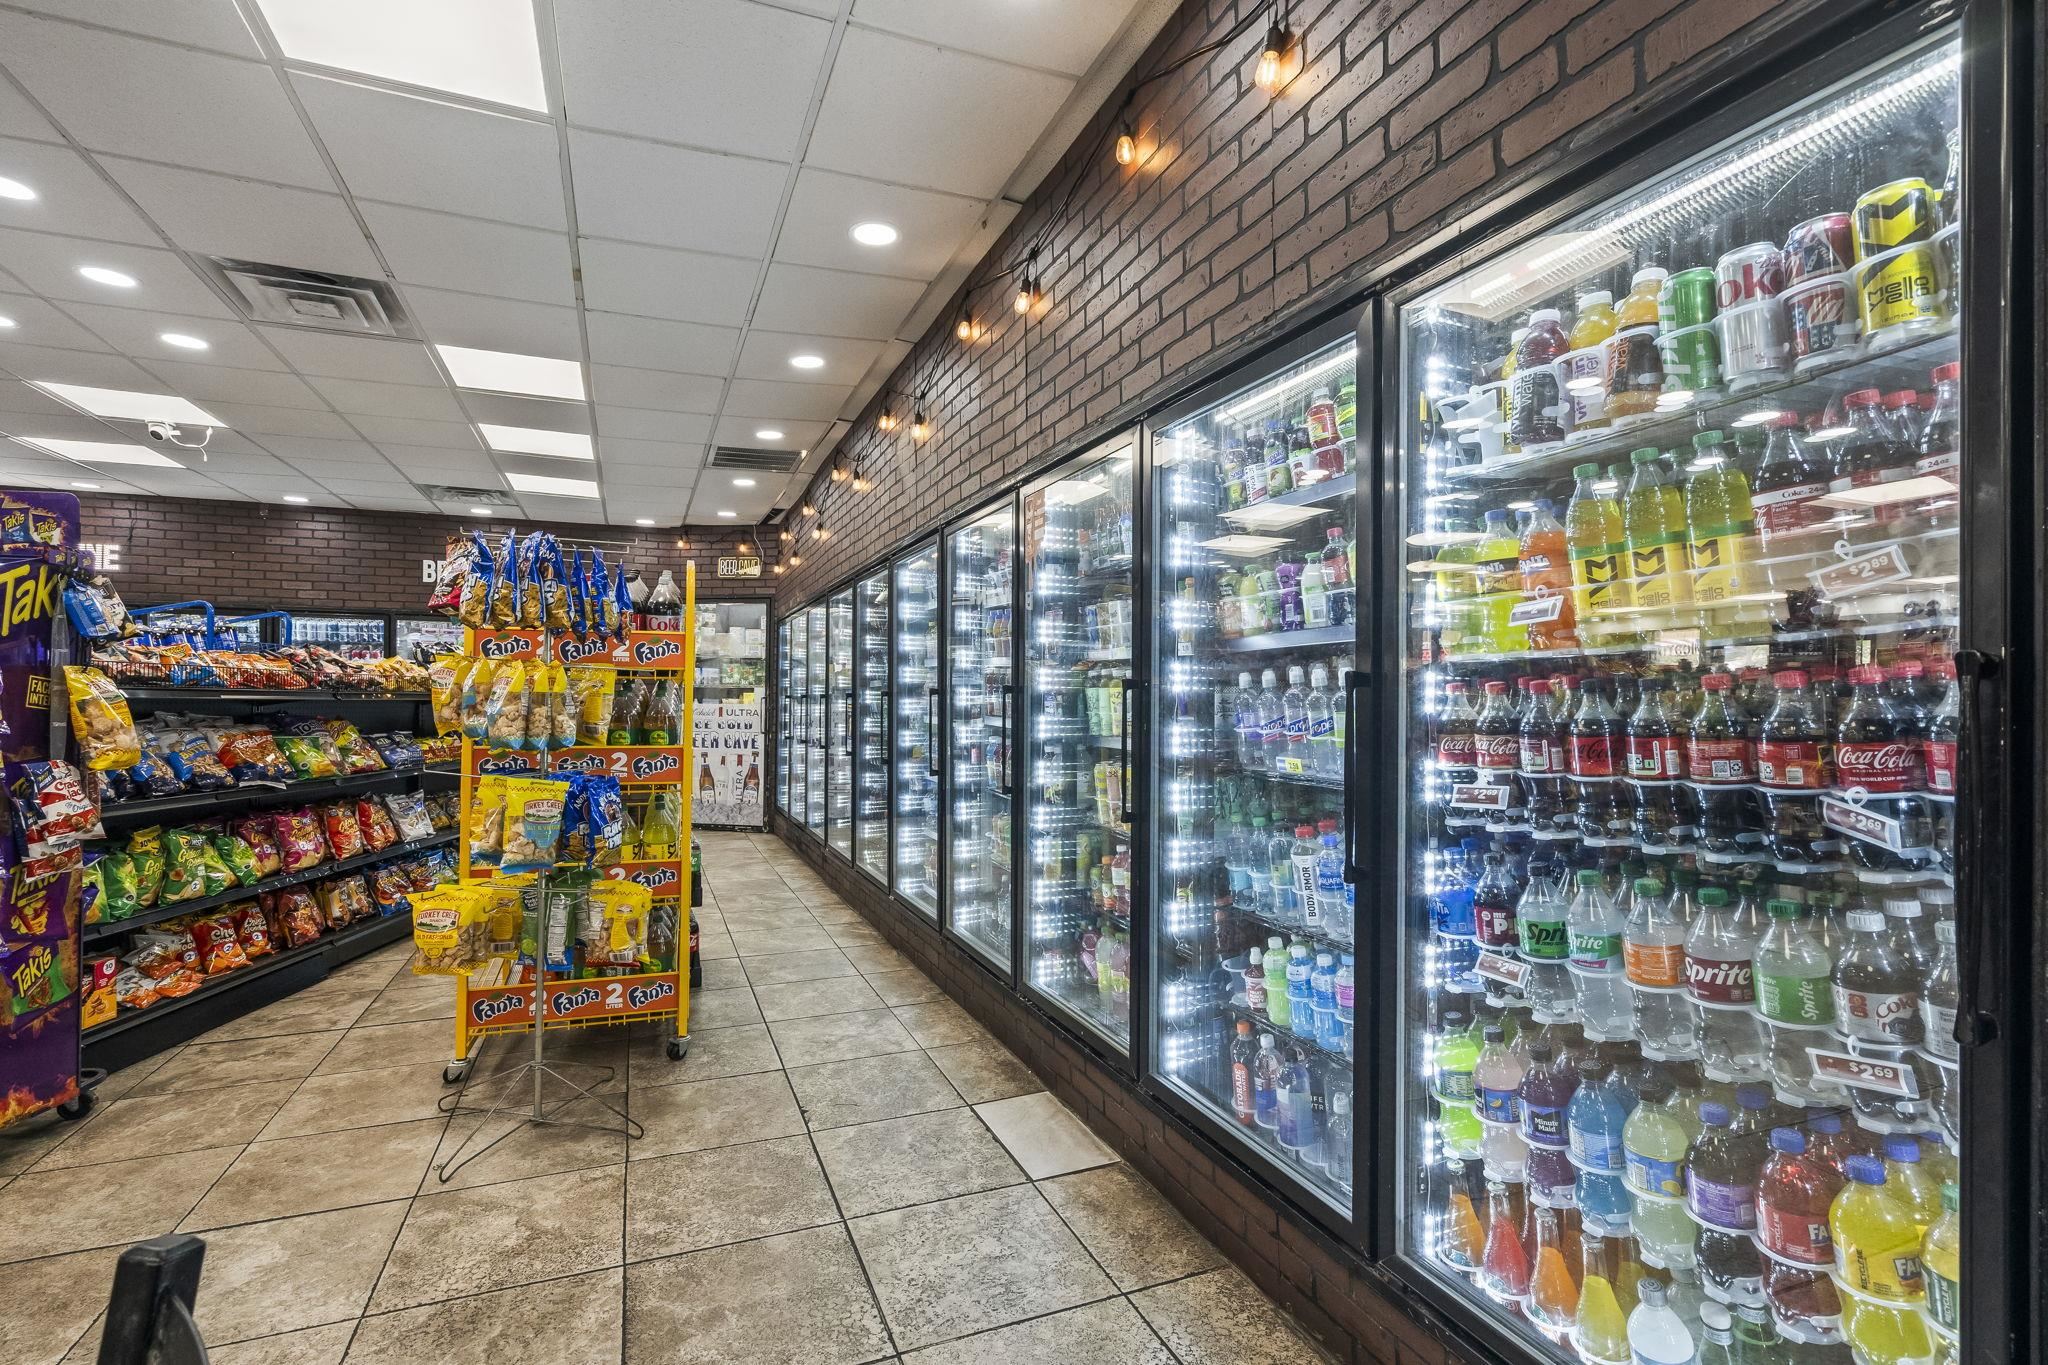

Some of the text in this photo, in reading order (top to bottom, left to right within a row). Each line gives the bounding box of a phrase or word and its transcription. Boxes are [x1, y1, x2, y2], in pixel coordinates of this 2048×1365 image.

[1868, 276, 1929, 301] Mello
[3, 513, 25, 529] Takis
[36, 521, 57, 536] Takis
[720, 560, 758, 575] BEER CAVE
[480, 635, 532, 657] Fanta
[559, 638, 608, 664] Fanta
[634, 639, 680, 665] Fanta
[726, 708, 760, 717] ULTRA
[718, 720, 753, 730] COLD
[725, 731, 760, 750] CAVE
[610, 752, 628, 771] 2
[632, 754, 678, 780] Fanta
[1839, 744, 1916, 769] Coca-Cola
[12, 948, 52, 998] Takis
[1684, 956, 1752, 986] Sprite
[472, 994, 525, 1023] Fanta
[552, 987, 600, 1016] Fanta
[606, 982, 623, 1004] 2
[627, 981, 675, 1009] Fanta
[1801, 981, 1817, 1021] Sprite
[1534, 1117, 1559, 1127] Minute
[1537, 1124, 1557, 1133] Maid
